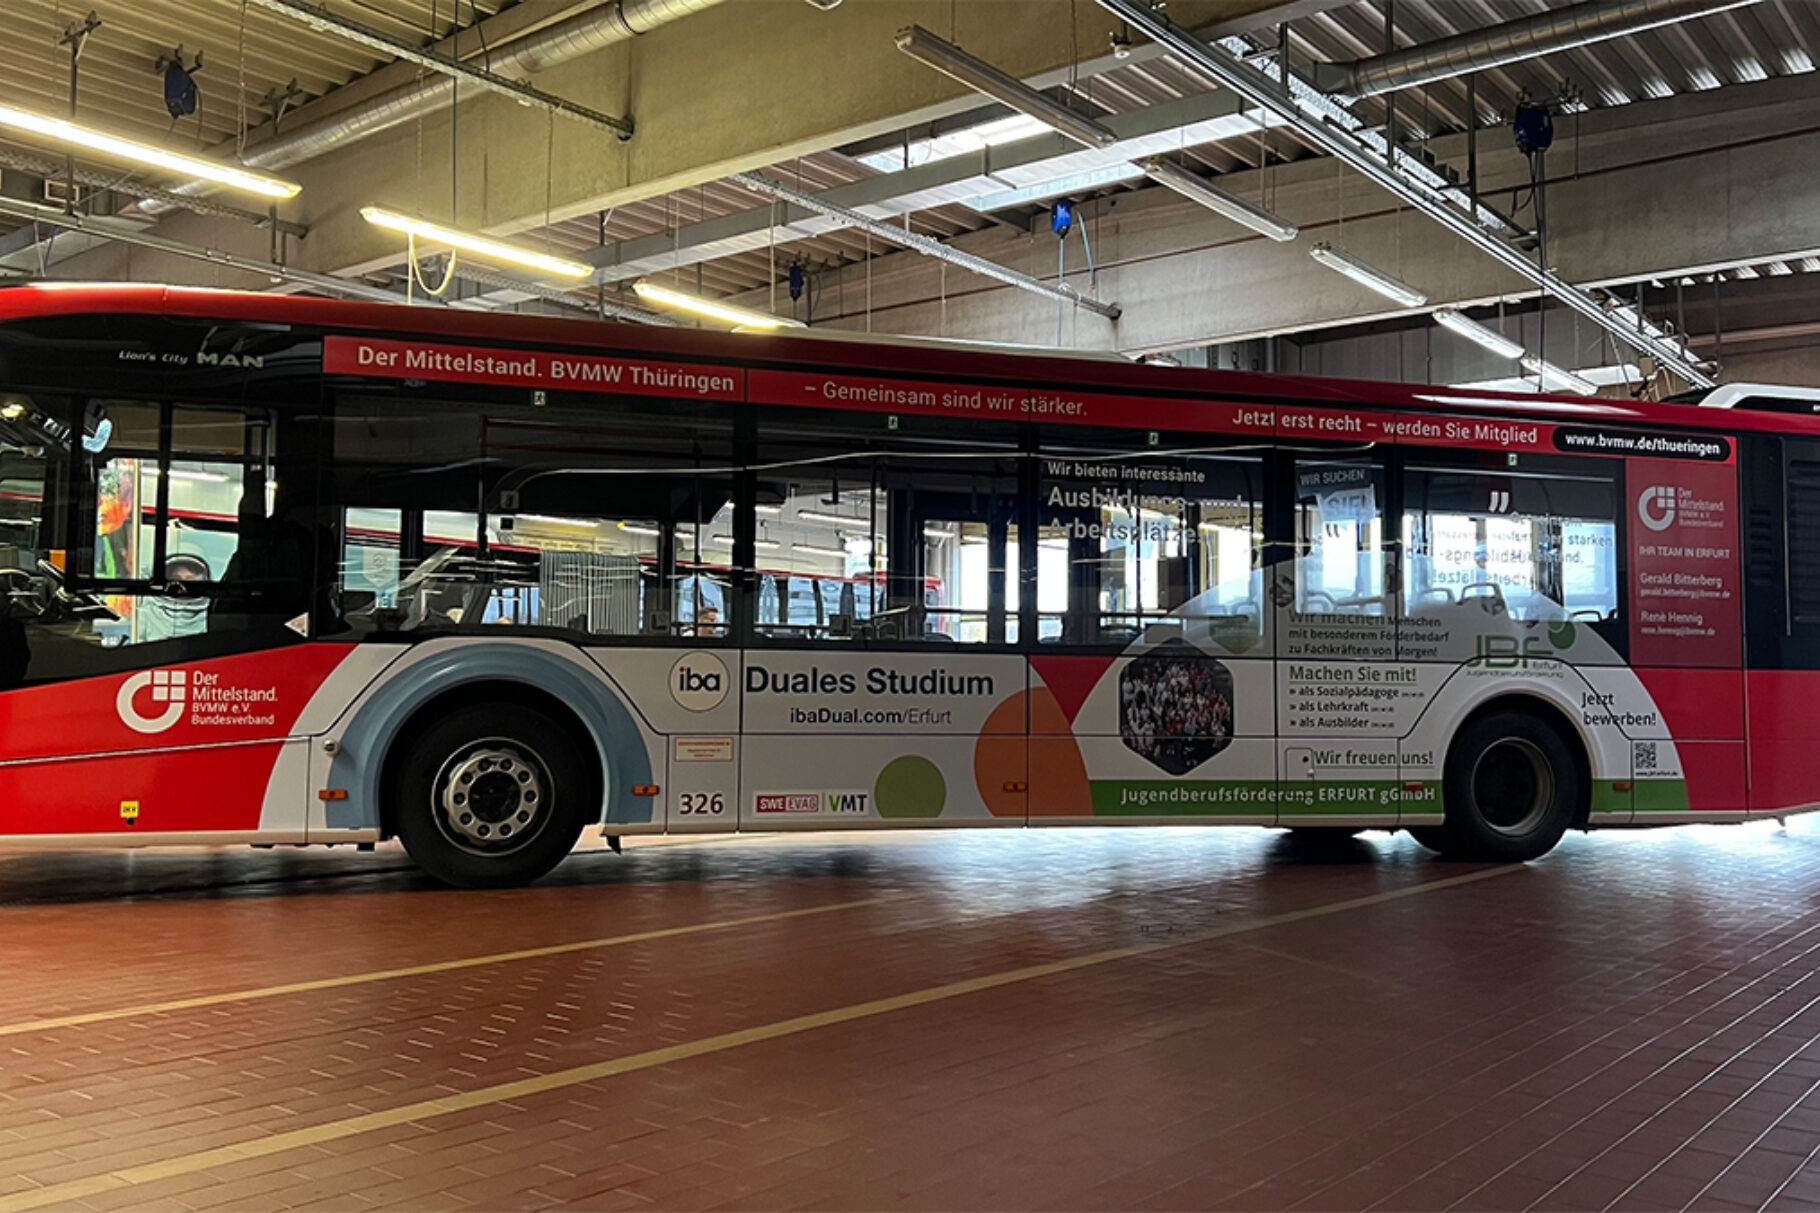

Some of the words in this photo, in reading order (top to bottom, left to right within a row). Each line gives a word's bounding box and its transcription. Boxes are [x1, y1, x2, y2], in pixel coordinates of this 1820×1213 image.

[118, 351, 156, 361] Lion's
[162, 353, 188, 365] City
[197, 351, 264, 368] MAN
[357, 346, 397, 367] Der
[405, 349, 544, 378] Mittelstand.
[550, 364, 623, 383] BVMW
[629, 366, 735, 393] Thüringen
[823, 380, 937, 406] Gemeinsam
[942, 389, 981, 409] sind
[987, 394, 1015, 411] wir
[1020, 396, 1088, 416] stärker.
[1232, 408, 1275, 426] Jetzt
[1281, 414, 1314, 430] erst
[1319, 415, 1362, 432] recht
[1382, 420, 1441, 438] werden
[1445, 423, 1470, 440] Sie
[1474, 424, 1538, 446] Mitglied
[1565, 433, 1720, 457] www.bvmw.de/thueringen
[1048, 462, 1071, 477] Wir
[1075, 462, 1118, 479] bieten
[1121, 464, 1206, 483] interessante
[1301, 473, 1321, 485] WIR
[1323, 469, 1365, 484] SUCHEN
[1639, 545, 1656, 557] IHR
[1657, 545, 1683, 557] TEAM
[1684, 547, 1695, 557] IN
[1696, 547, 1730, 559] ERFURT
[1640, 572, 1672, 584] Gerald
[1289, 609, 1315, 625] Wir
[1288, 628, 1308, 639] mit
[1310, 629, 1378, 640] besonderem
[1288, 645, 1301, 654] zu
[1304, 643, 1369, 655] Fachkräften
[1372, 647, 1392, 656] von
[192, 671, 218, 685] Der
[679, 666, 721, 692] iba
[746, 666, 856, 694] Duales
[866, 667, 994, 695] Studium
[1289, 666, 1353, 681] Machen
[1358, 666, 1382, 681] Sie
[1385, 667, 1417, 682] mit!
[192, 686, 278, 702] Mittelstand.
[1299, 686, 1315, 696] als
[1317, 686, 1400, 700] Sozialpädagoge
[1581, 691, 1614, 708] Jetzt
[192, 702, 226, 713] BVMW
[1299, 701, 1315, 712] als
[1317, 701, 1369, 712] Lehrkraft
[191, 714, 275, 725] Bundesverband
[789, 707, 952, 725] ibaDual.com/Erfurt
[1299, 716, 1315, 727] als
[1317, 717, 1369, 728] Ausbilder
[1583, 711, 1656, 726] bewerben!
[1314, 750, 1341, 765] Wir
[1346, 750, 1396, 765] freuen
[1402, 751, 1433, 765] uns!
[760, 797, 785, 810] SWE
[828, 794, 868, 812] VMT
[1119, 786, 1314, 806] Jugendberufsförderung
[1318, 787, 1375, 801] ERFURT
[680, 794, 724, 815] 326
